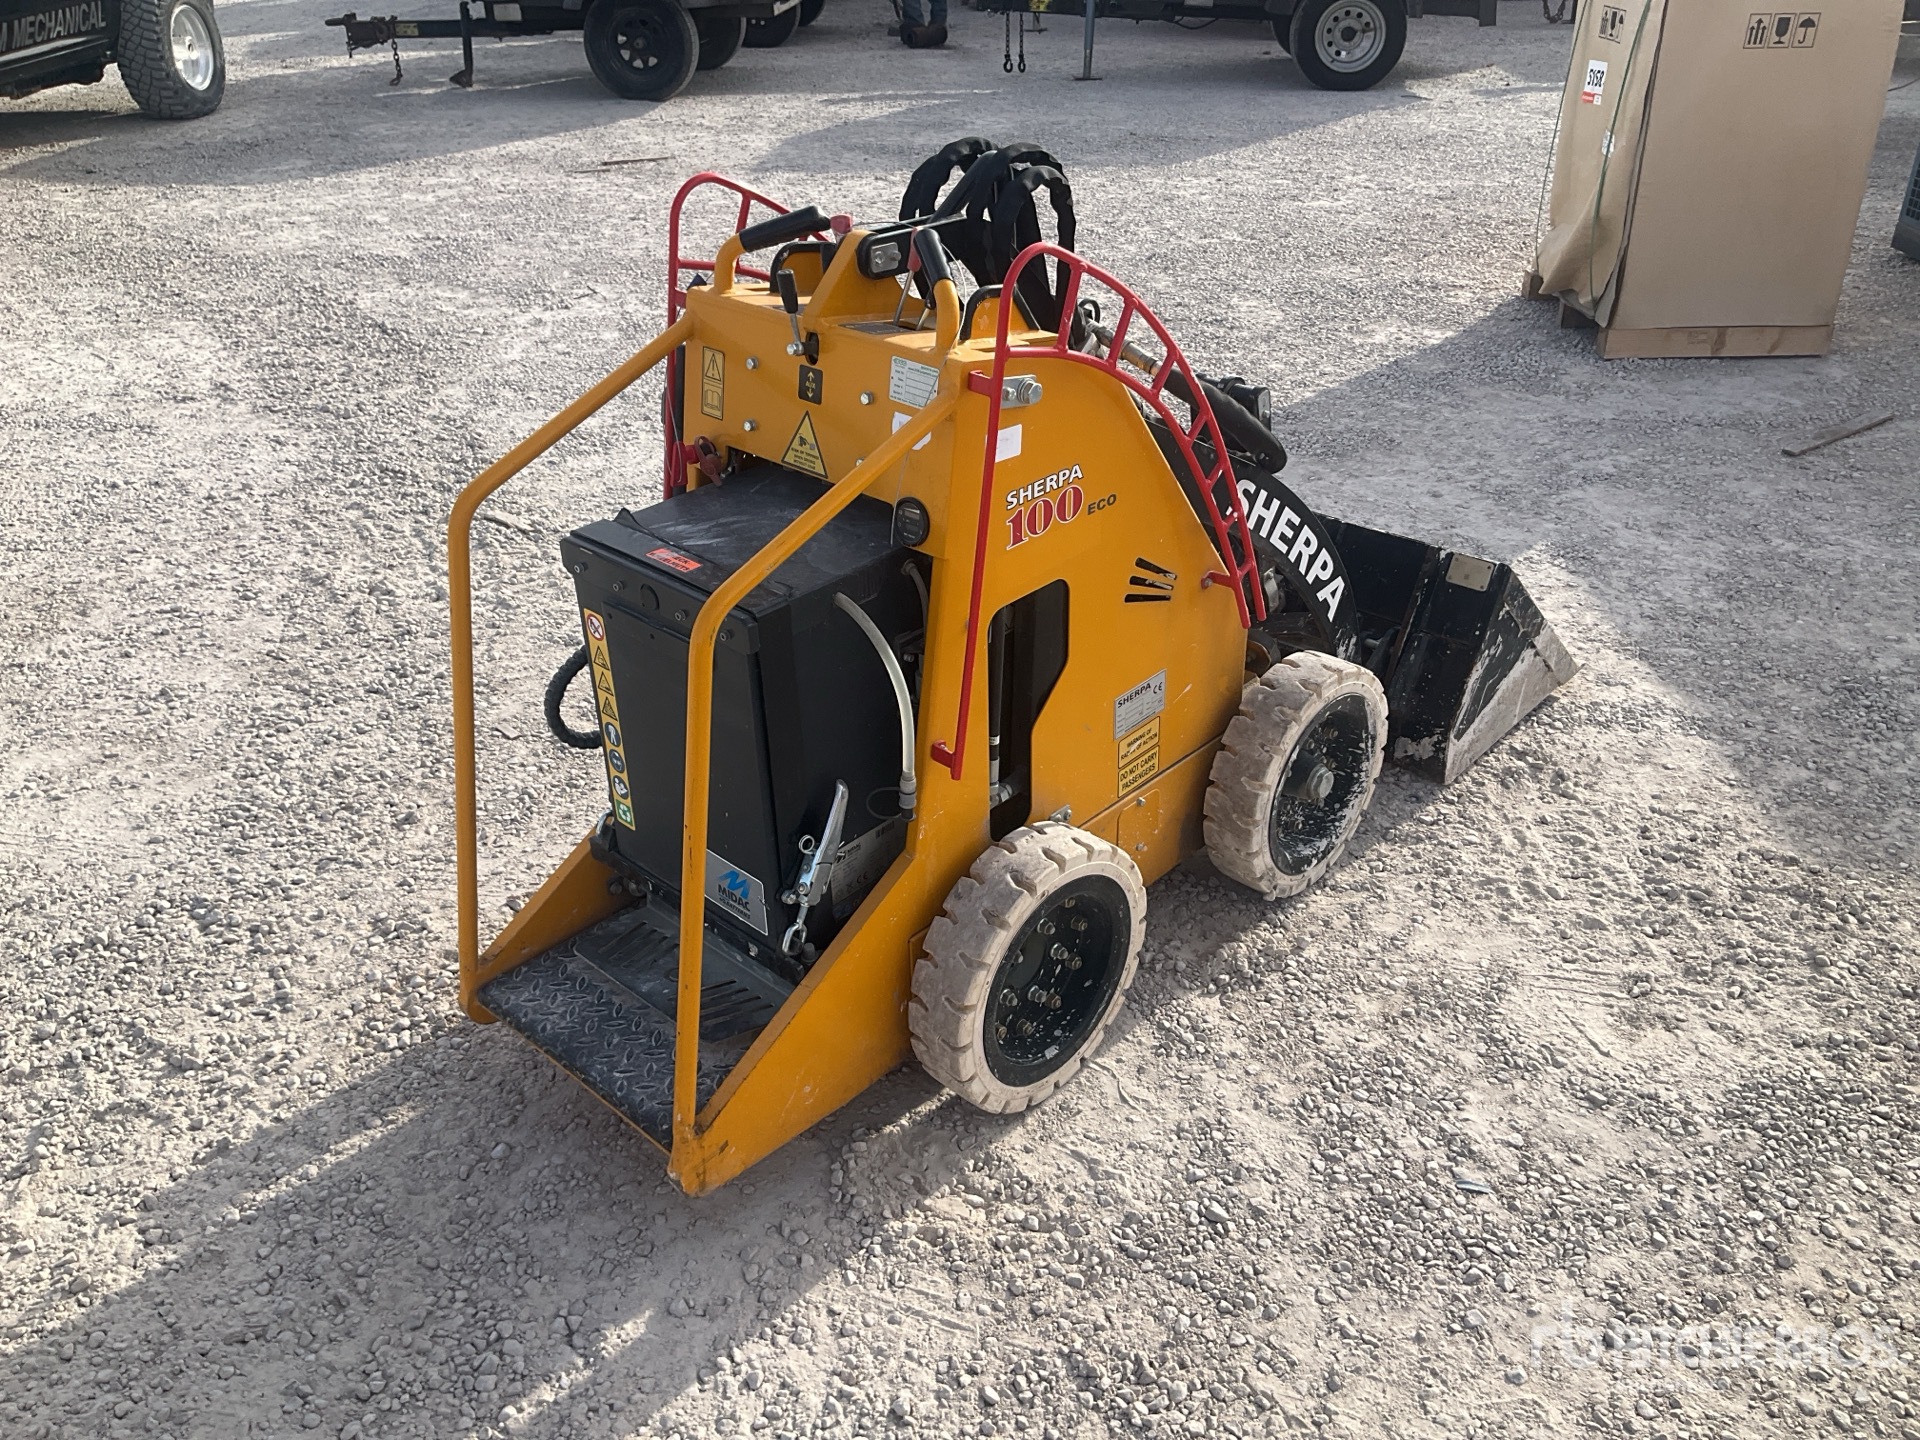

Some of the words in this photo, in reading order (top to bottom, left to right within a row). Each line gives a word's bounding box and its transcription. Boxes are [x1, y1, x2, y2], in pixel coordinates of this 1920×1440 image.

[12, 1, 107, 49] MECHANICAL
[1006, 464, 1084, 511] SHERPA
[1006, 485, 1084, 551] 100
[1087, 494, 1117, 516] ECO
[1226, 479, 1345, 623] SHERPA
[1117, 683, 1151, 709] SHERPA
[1143, 732, 1158, 746] ACTION
[1120, 770, 1128, 781] DO
[1129, 763, 1140, 775] NOT
[1140, 750, 1158, 768] CARRY
[1121, 763, 1156, 791] PASSENGERS
[718, 884, 751, 912] MIDAC
